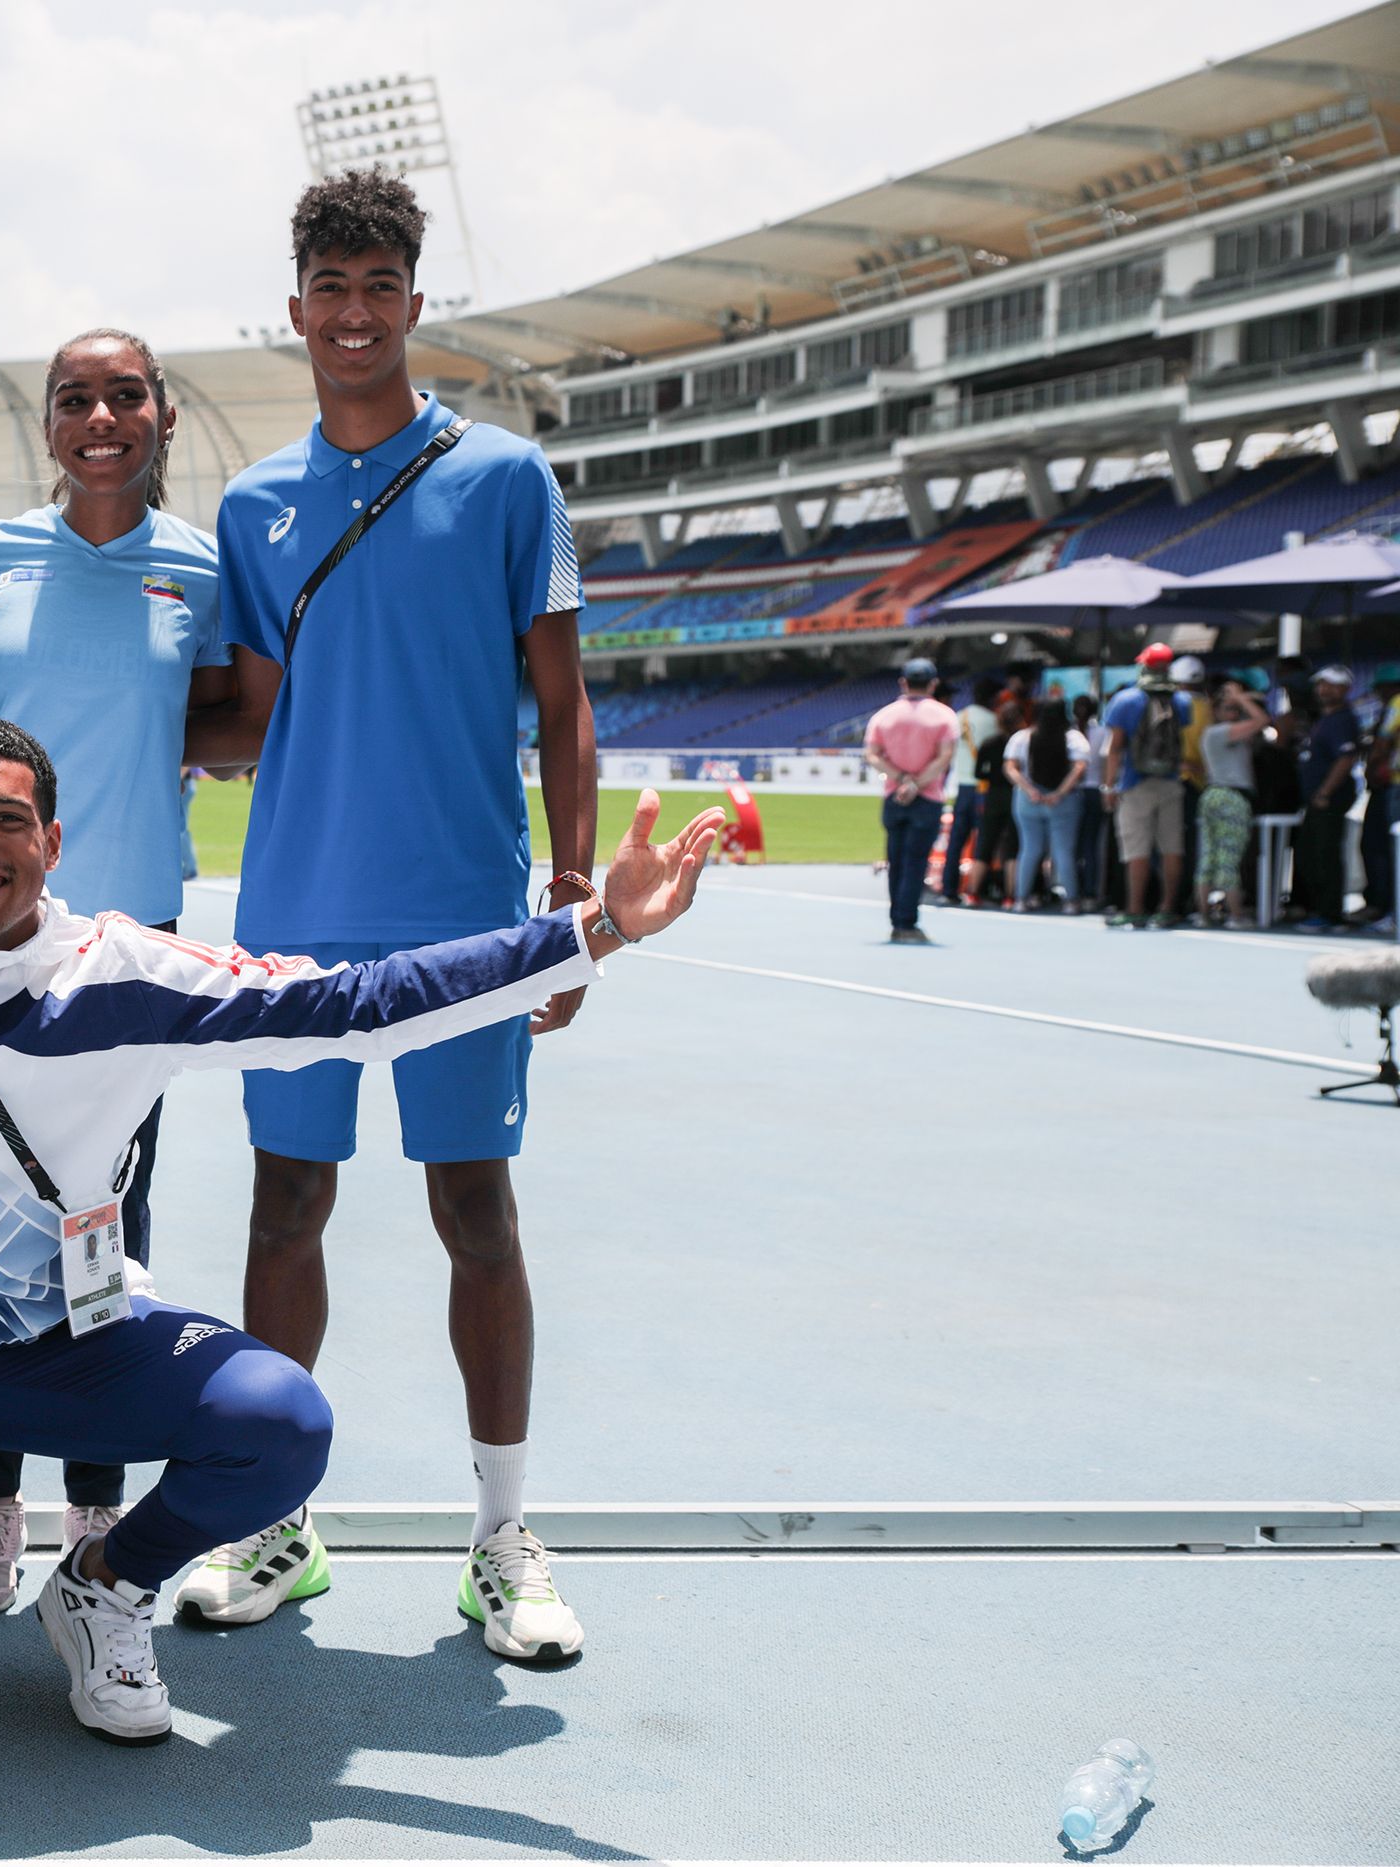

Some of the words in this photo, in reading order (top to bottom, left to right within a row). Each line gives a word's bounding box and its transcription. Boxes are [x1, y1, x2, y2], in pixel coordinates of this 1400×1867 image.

[381, 483, 401, 505] WORLD
[399, 456, 428, 486] ATHLETICS
[87, 1290, 107, 1302] ATHLETE
[173, 1327, 235, 1356] adidas
